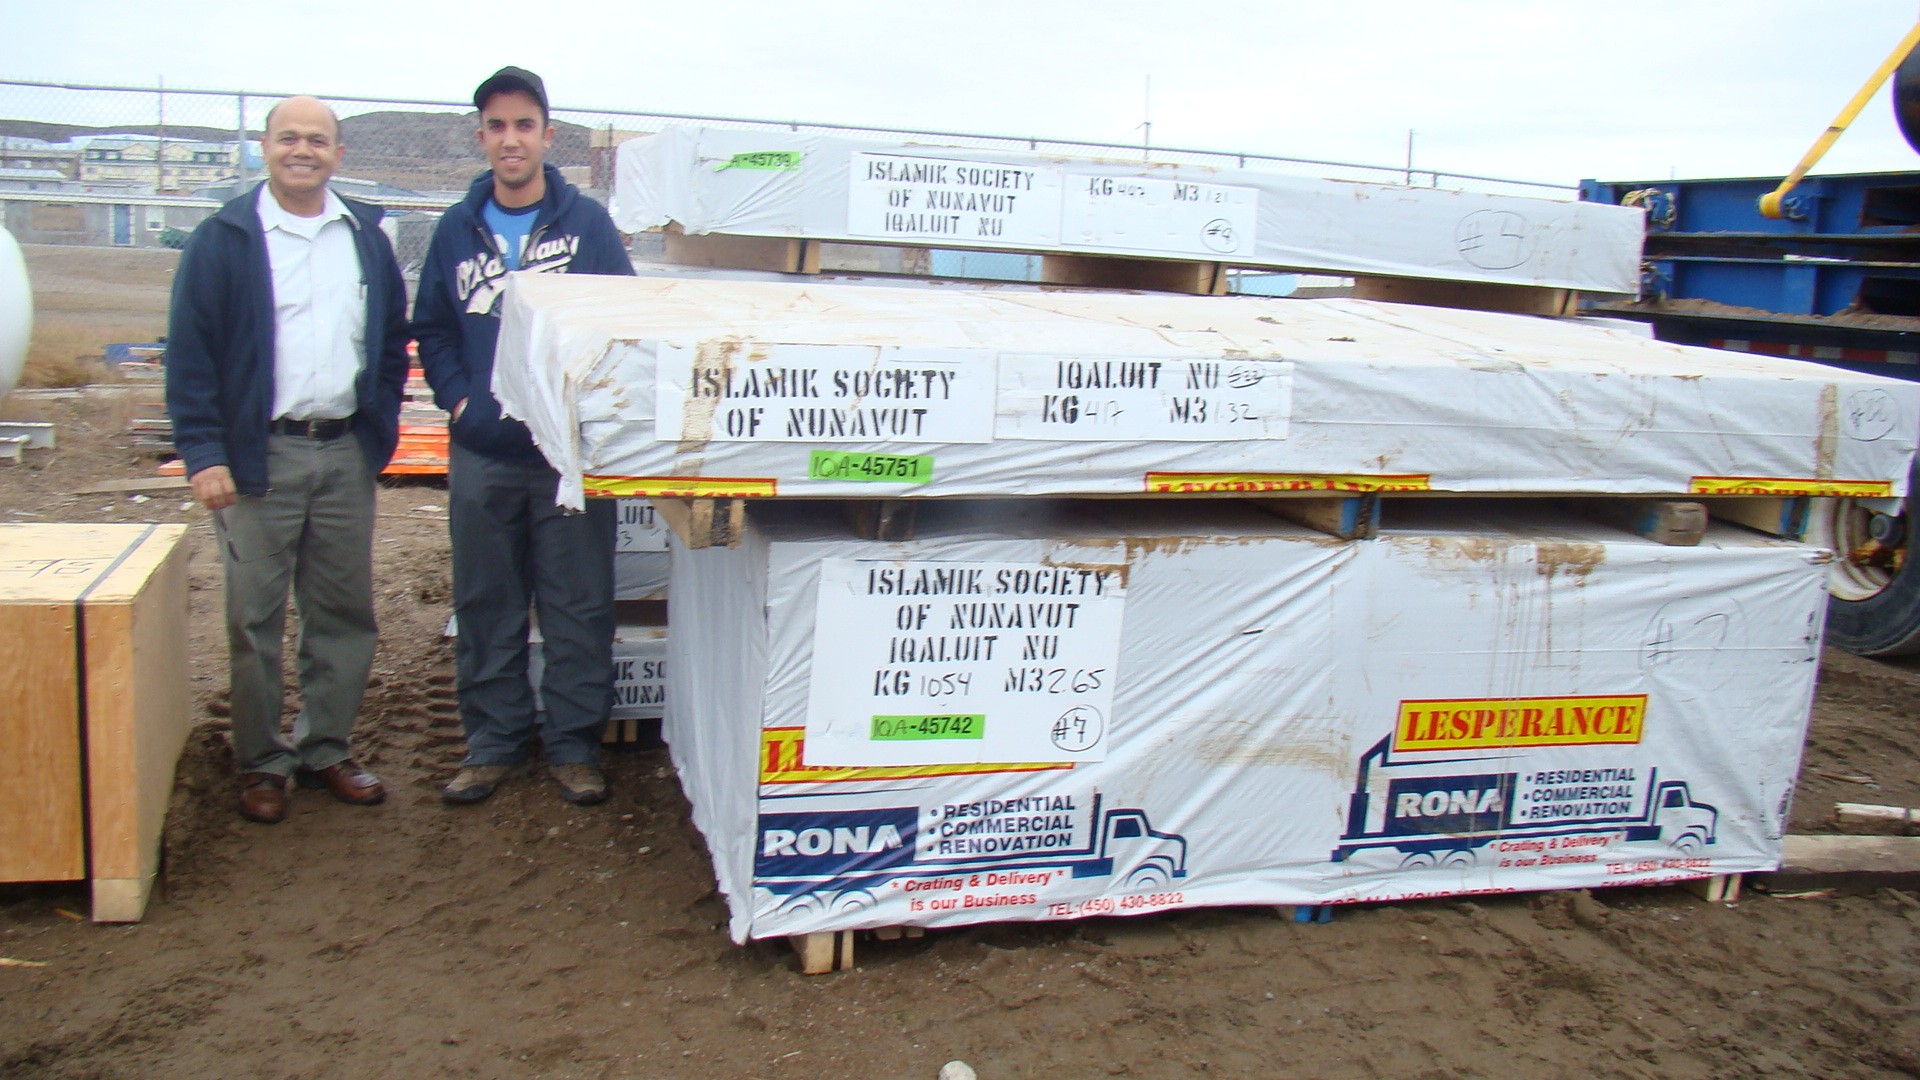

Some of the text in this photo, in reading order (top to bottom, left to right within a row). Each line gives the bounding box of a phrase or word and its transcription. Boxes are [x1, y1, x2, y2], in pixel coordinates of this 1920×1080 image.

[868, 161, 1035, 190] ISLAMIK SOCIETY
[888, 188, 1016, 214] OF NUNAVUT
[1089, 177, 1113, 196] KG
[1173, 183, 1199, 202] M3
[885, 212, 1004, 237] IQALUIT NU
[692, 367, 956, 400] ISLAMIK SOCIETY
[1057, 361, 1162, 389] IQALUIT
[1187, 362, 1219, 390] NU
[727, 408, 927, 437] OF NUNAVUT
[1042, 395, 1079, 424] KG
[1170, 396, 1207, 424] M3
[867, 568, 1112, 597] ISLAMIK SOCIETY
[896, 602, 1080, 631] OF NUNAVUT
[889, 635, 1060, 664] IQALUIT NU
[874, 670, 911, 696] KG
[920, 671, 974, 697] 1054
[1004, 667, 1043, 692] M3
[1052, 714, 1087, 744] #7
[1403, 705, 1637, 742] LESPERANCE
[1535, 768, 1636, 785] RESIDENTIAL
[1395, 788, 1502, 818] RONA
[1531, 785, 1633, 802] COMMERCIAL
[944, 795, 1075, 820] RESIDENTIAL
[1529, 802, 1631, 819] RENOVATION
[940, 815, 1074, 838] COMMERCIAL
[763, 824, 903, 857] RONA
[939, 832, 1071, 855] RENOVATION
[1499, 834, 1611, 853] Crating & Delivery
[1498, 854, 1598, 867] is our Business
[904, 869, 1052, 893] Crating & Delivery
[910, 893, 1037, 912] is our Business
[1120, 892, 1184, 910] 430-8822
